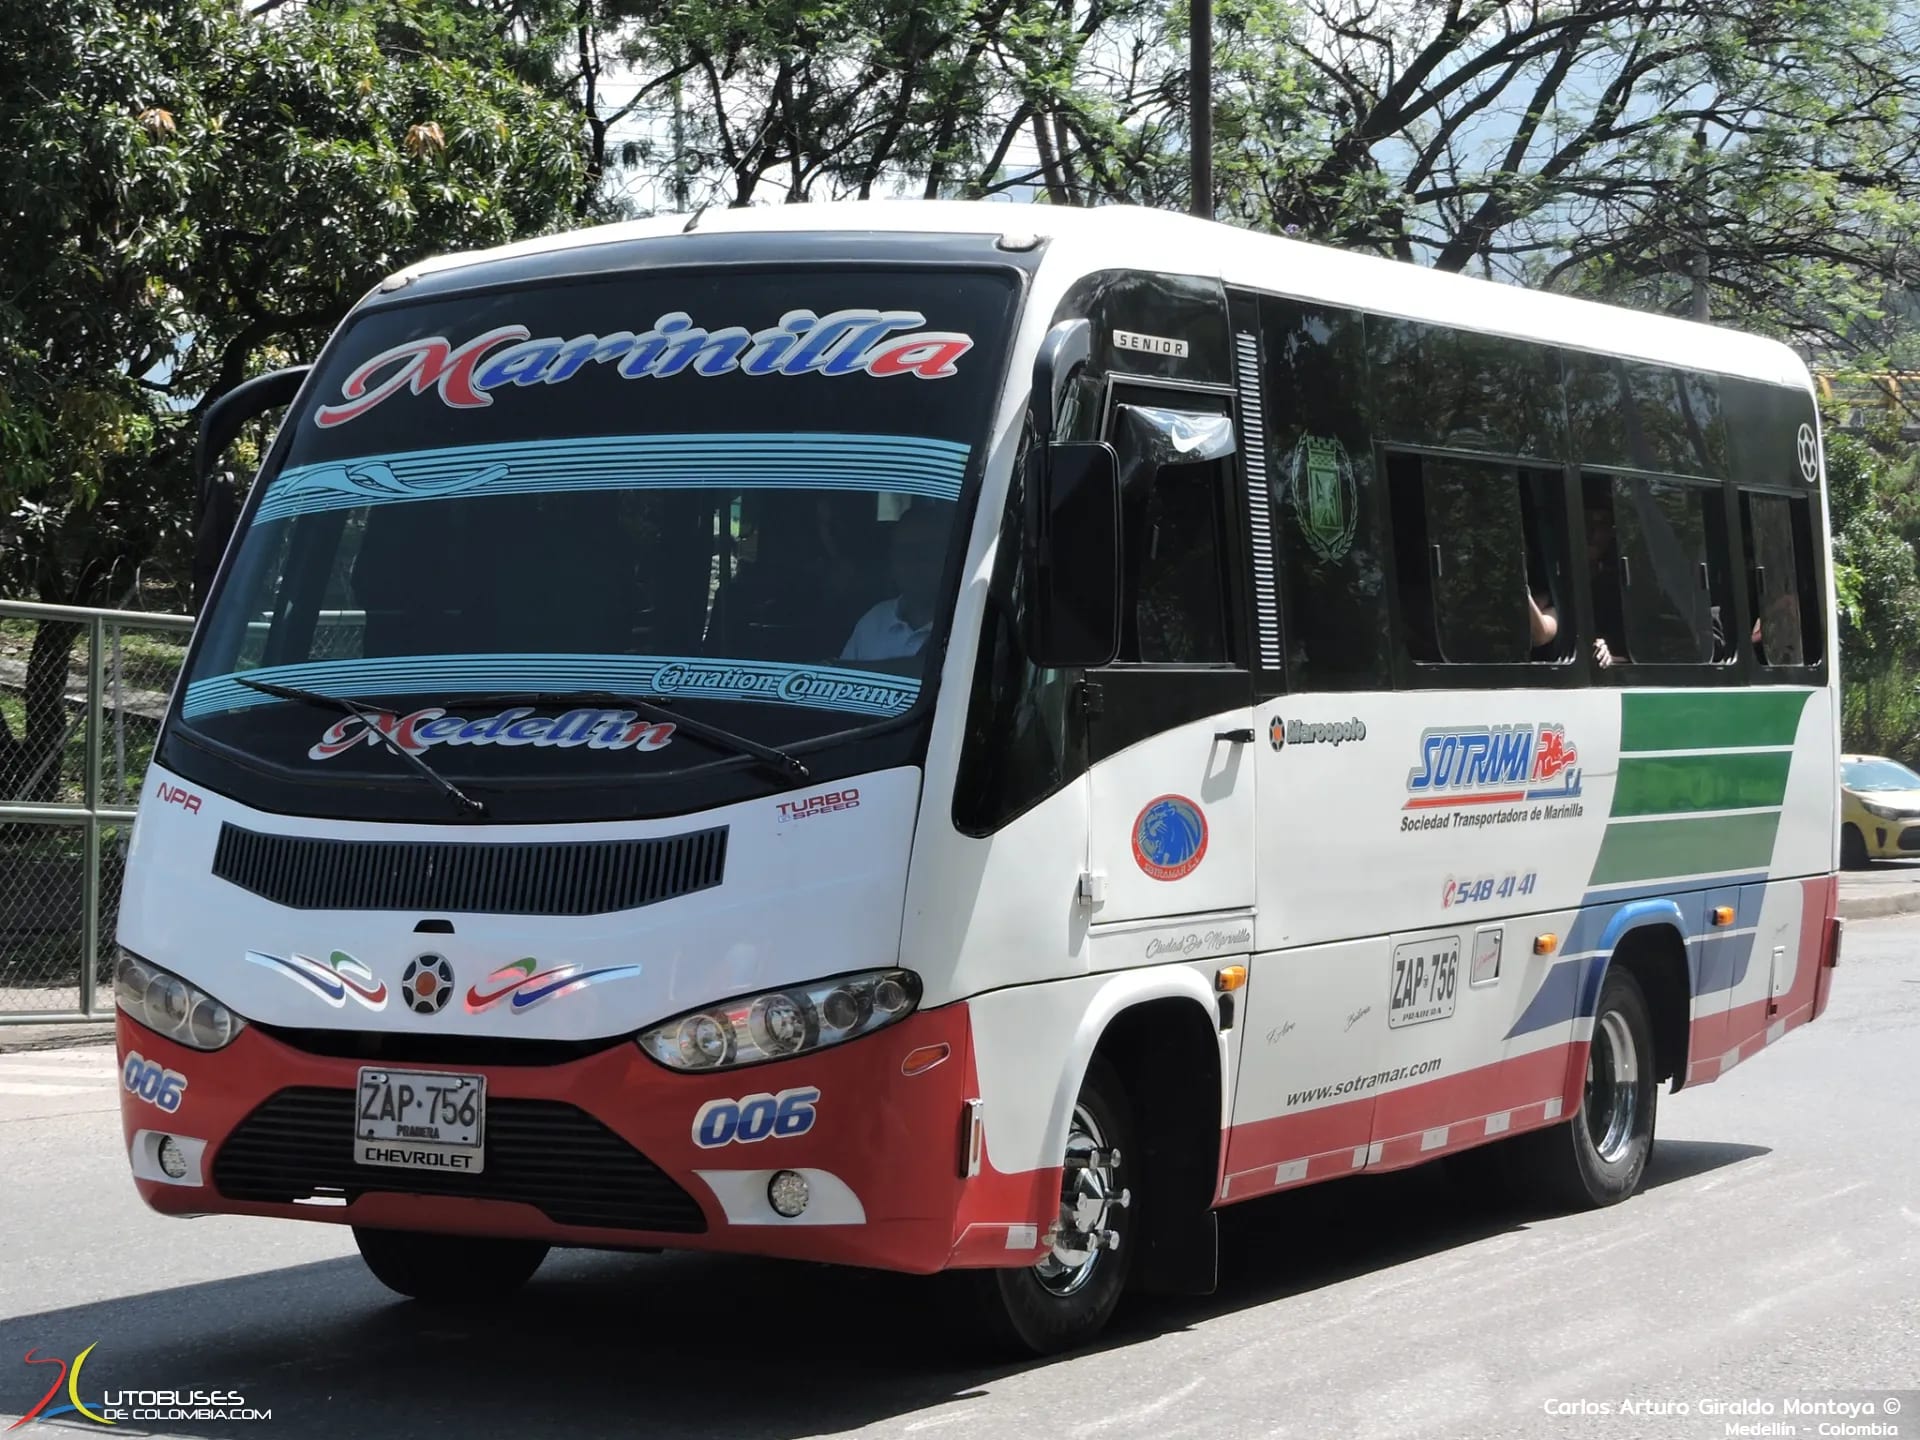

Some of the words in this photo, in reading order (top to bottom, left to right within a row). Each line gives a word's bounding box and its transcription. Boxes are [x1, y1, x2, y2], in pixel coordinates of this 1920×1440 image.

[1119, 334, 1183, 355] SENIOR
[314, 309, 974, 429] Marinilla
[651, 662, 773, 693] Carnation
[776, 671, 909, 709] Company
[156, 782, 202, 815] NPR
[776, 788, 860, 816] TURBO
[793, 800, 860, 820] SPEED
[1400, 813, 1450, 832] Sociedad
[1453, 804, 1528, 829] Transportadora
[1530, 806, 1541, 820] de
[1543, 802, 1584, 820] Marinilla
[1454, 879, 1495, 904] 548
[1496, 876, 1516, 898] 41
[1517, 873, 1537, 895] 41
[124, 1050, 188, 1113] 006
[1286, 1057, 1442, 1106] www.sotramar.com
[691, 1085, 821, 1149] 006
[365, 1147, 473, 1169] CHEVROLET
